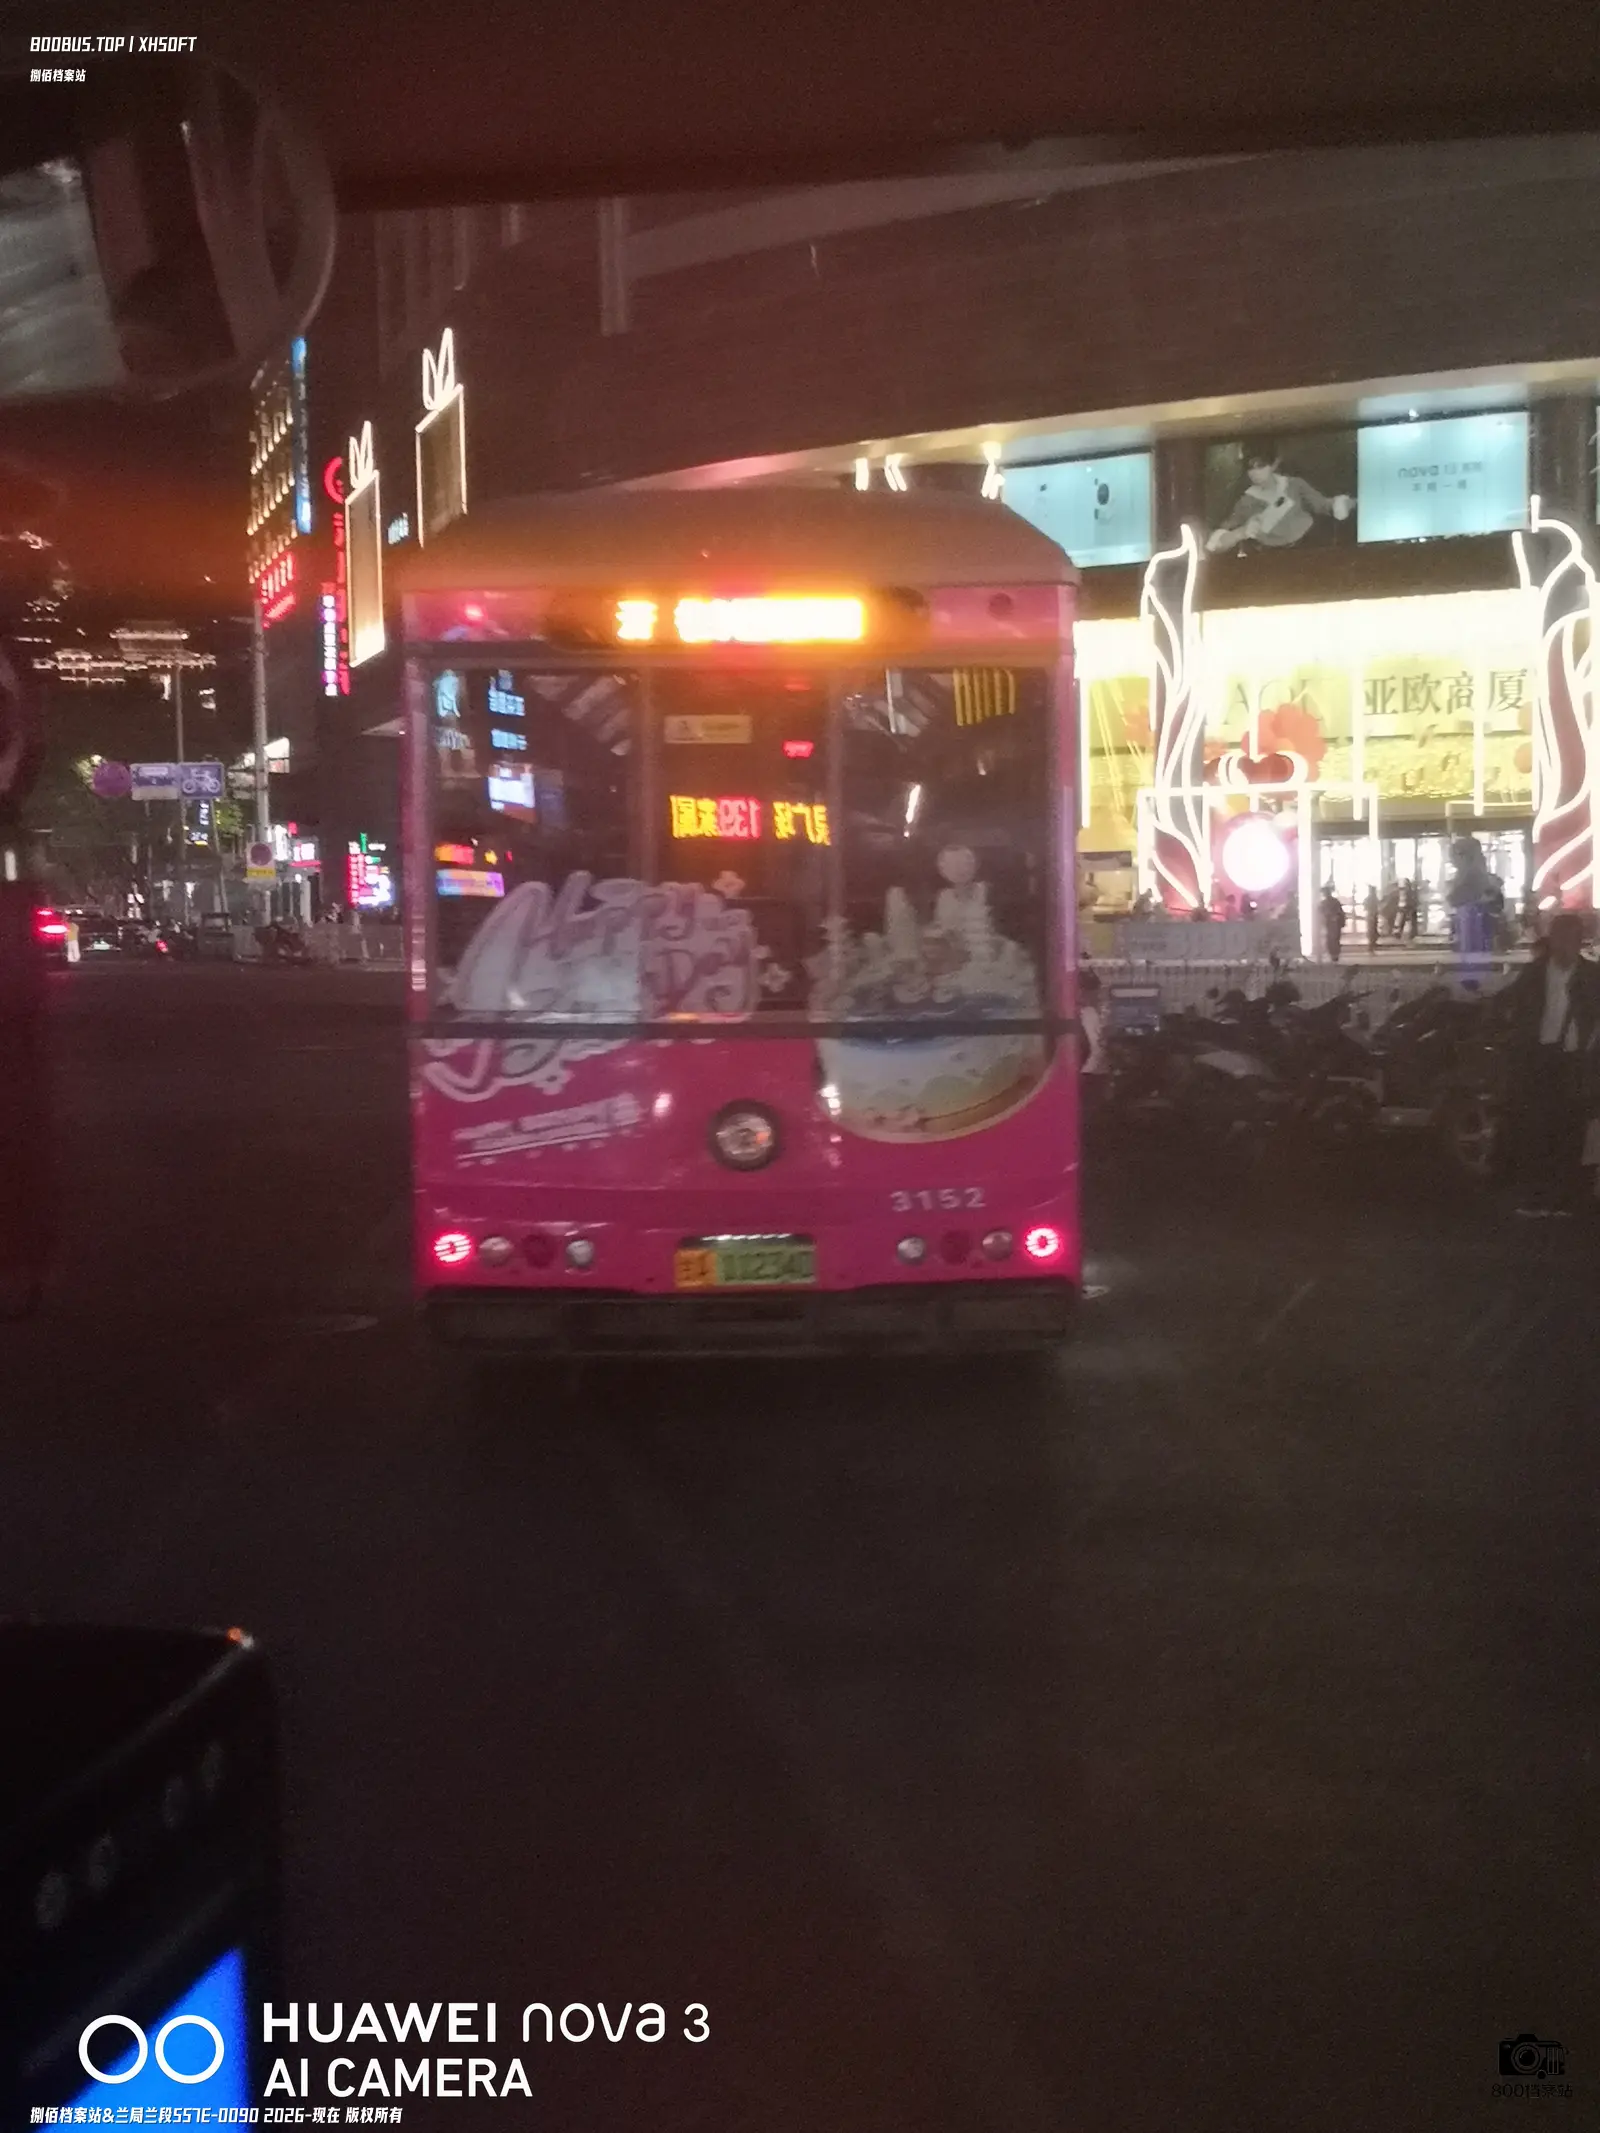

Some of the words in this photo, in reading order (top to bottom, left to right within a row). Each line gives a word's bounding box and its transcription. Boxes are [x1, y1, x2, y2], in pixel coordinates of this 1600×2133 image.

[1362, 668, 1528, 716] 亚欧商厦
[890, 1187, 987, 1212] 3152
